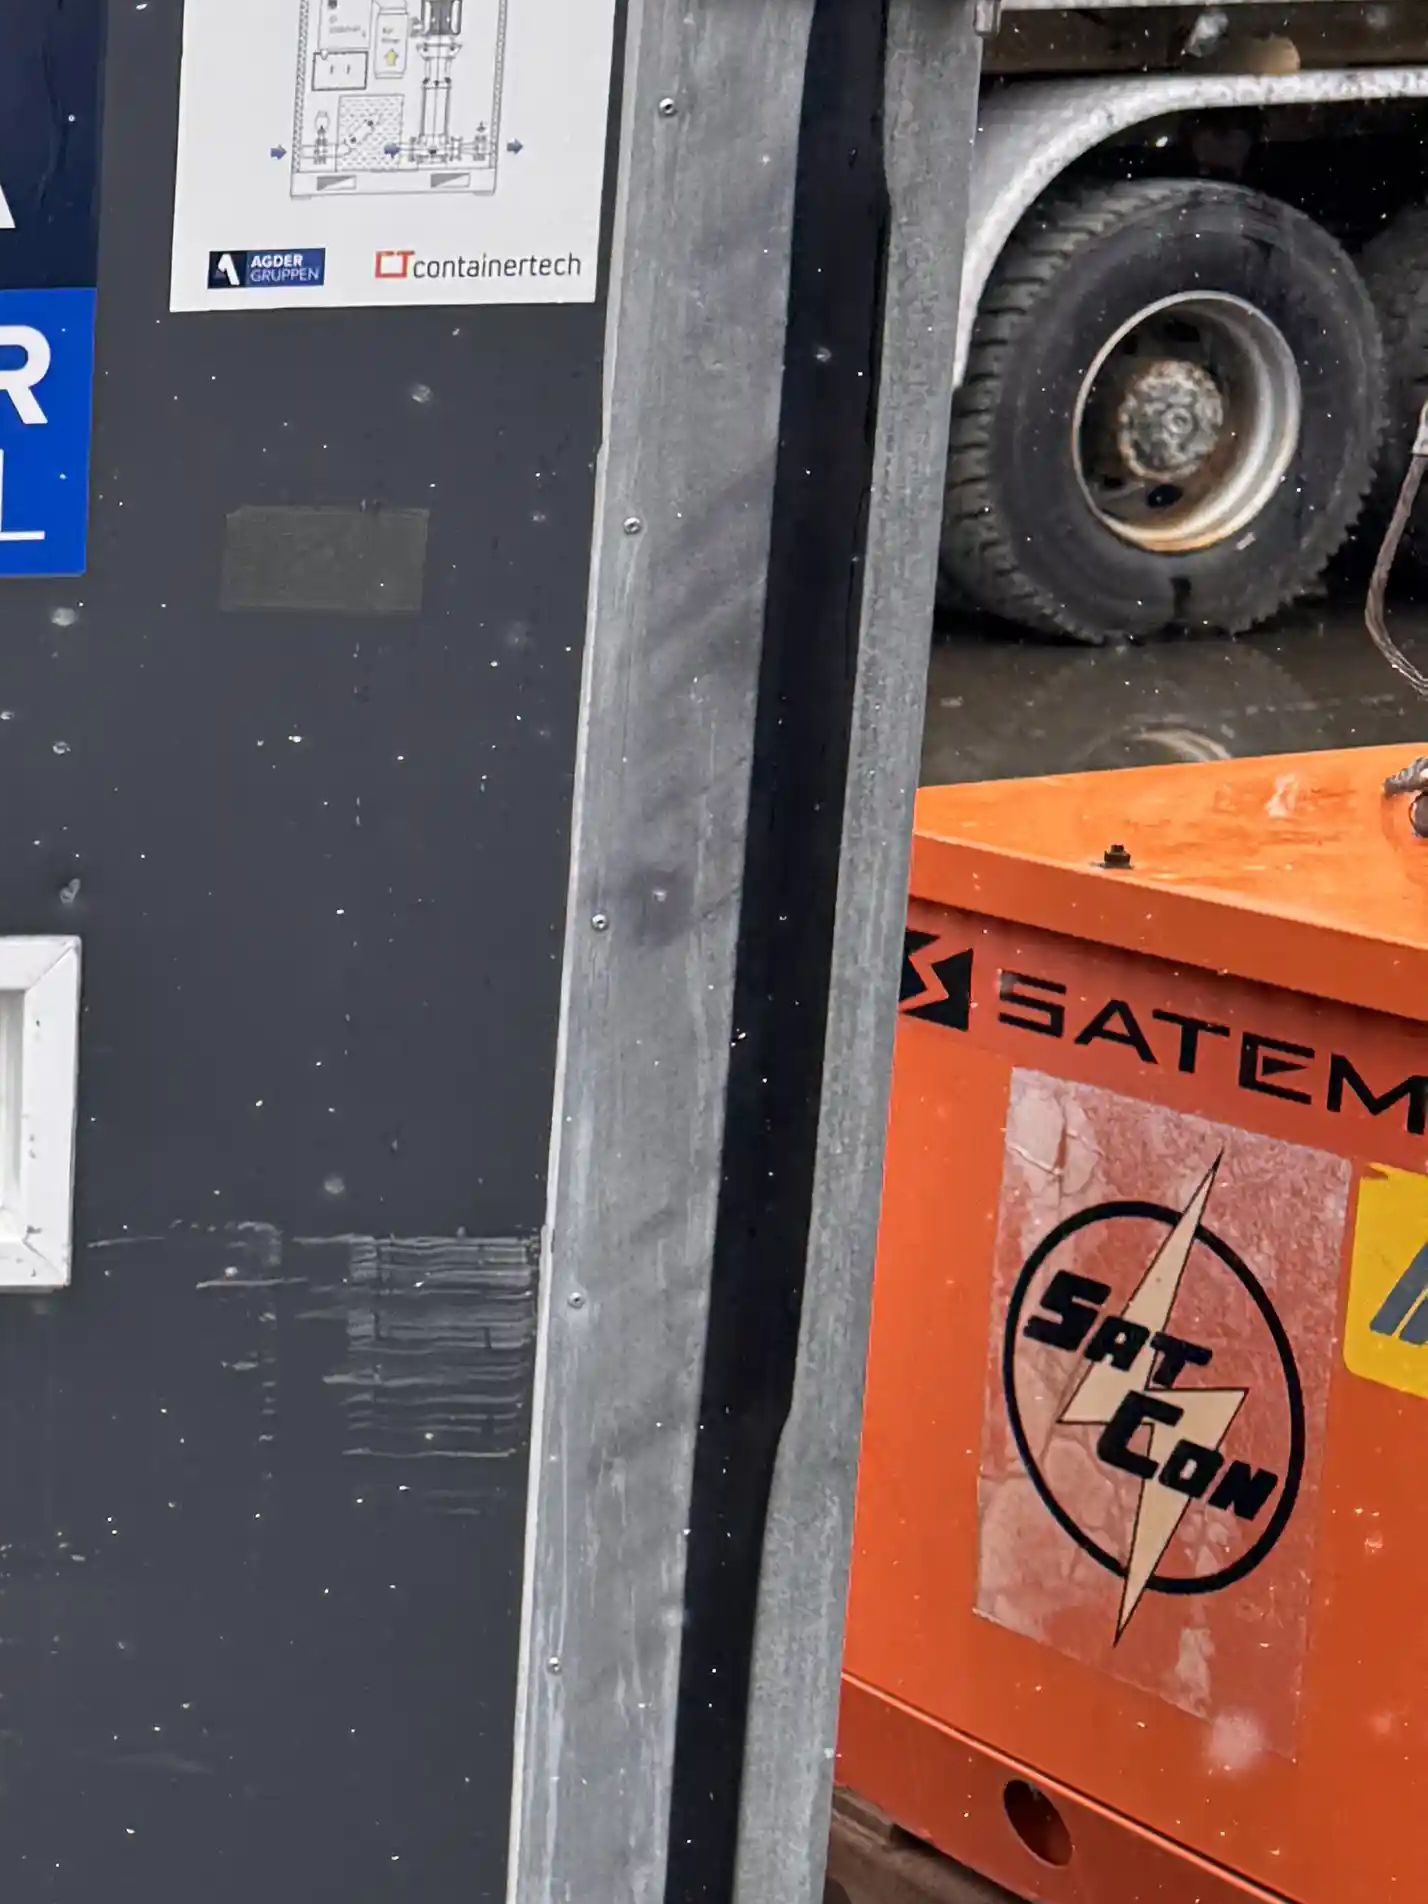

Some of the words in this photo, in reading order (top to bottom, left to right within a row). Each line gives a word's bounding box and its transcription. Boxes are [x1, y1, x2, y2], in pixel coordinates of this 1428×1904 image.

[250, 253, 304, 268] AGDER
[412, 251, 582, 279] containertech
[249, 266, 320, 282] GRUPPEN
[997, 969, 1428, 1135] SATEM
